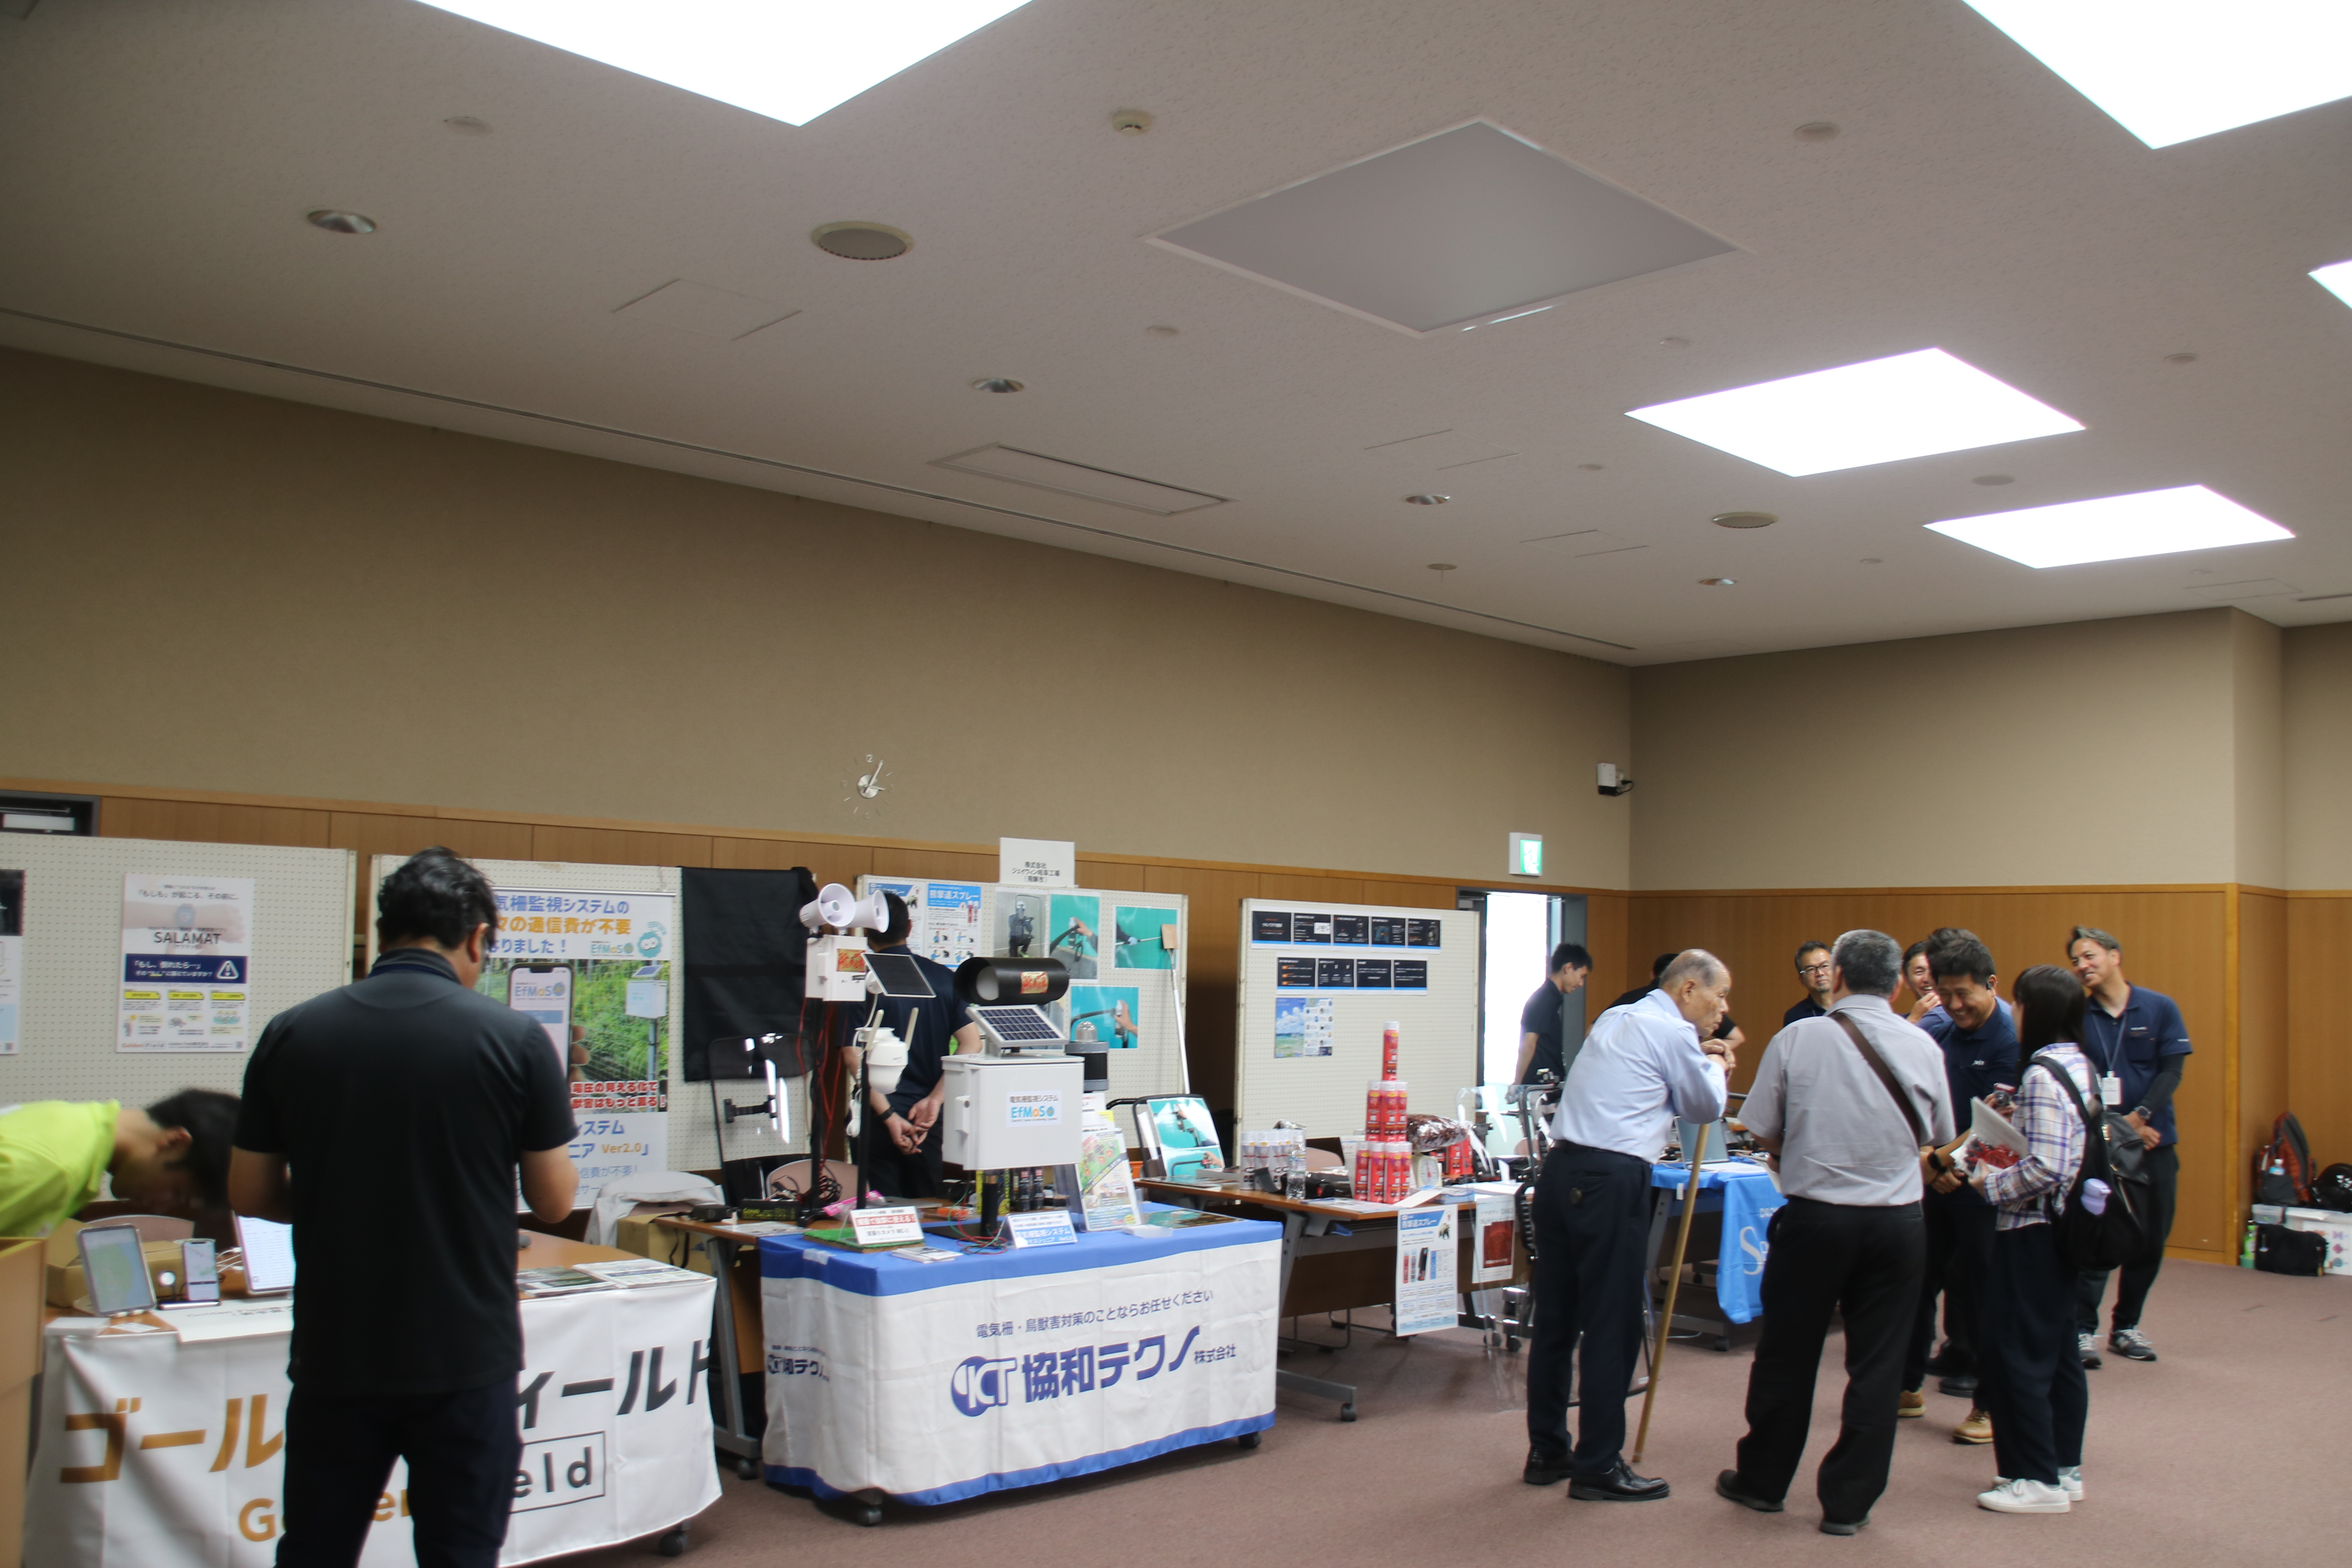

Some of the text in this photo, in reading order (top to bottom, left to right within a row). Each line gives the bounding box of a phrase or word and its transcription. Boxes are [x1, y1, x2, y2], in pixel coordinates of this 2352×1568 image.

[154, 932, 221, 945] SALAMAT
[1011, 1106, 1045, 1118] EfMoS
[575, 1165, 638, 1178] 信費が不要！
[976, 1289, 1214, 1338] 電気柵・鳥獣害対策のことならお任せください
[1022, 1325, 1236, 1403] 協和テクノ 株式会社
[514, 1446, 593, 1498] eld
